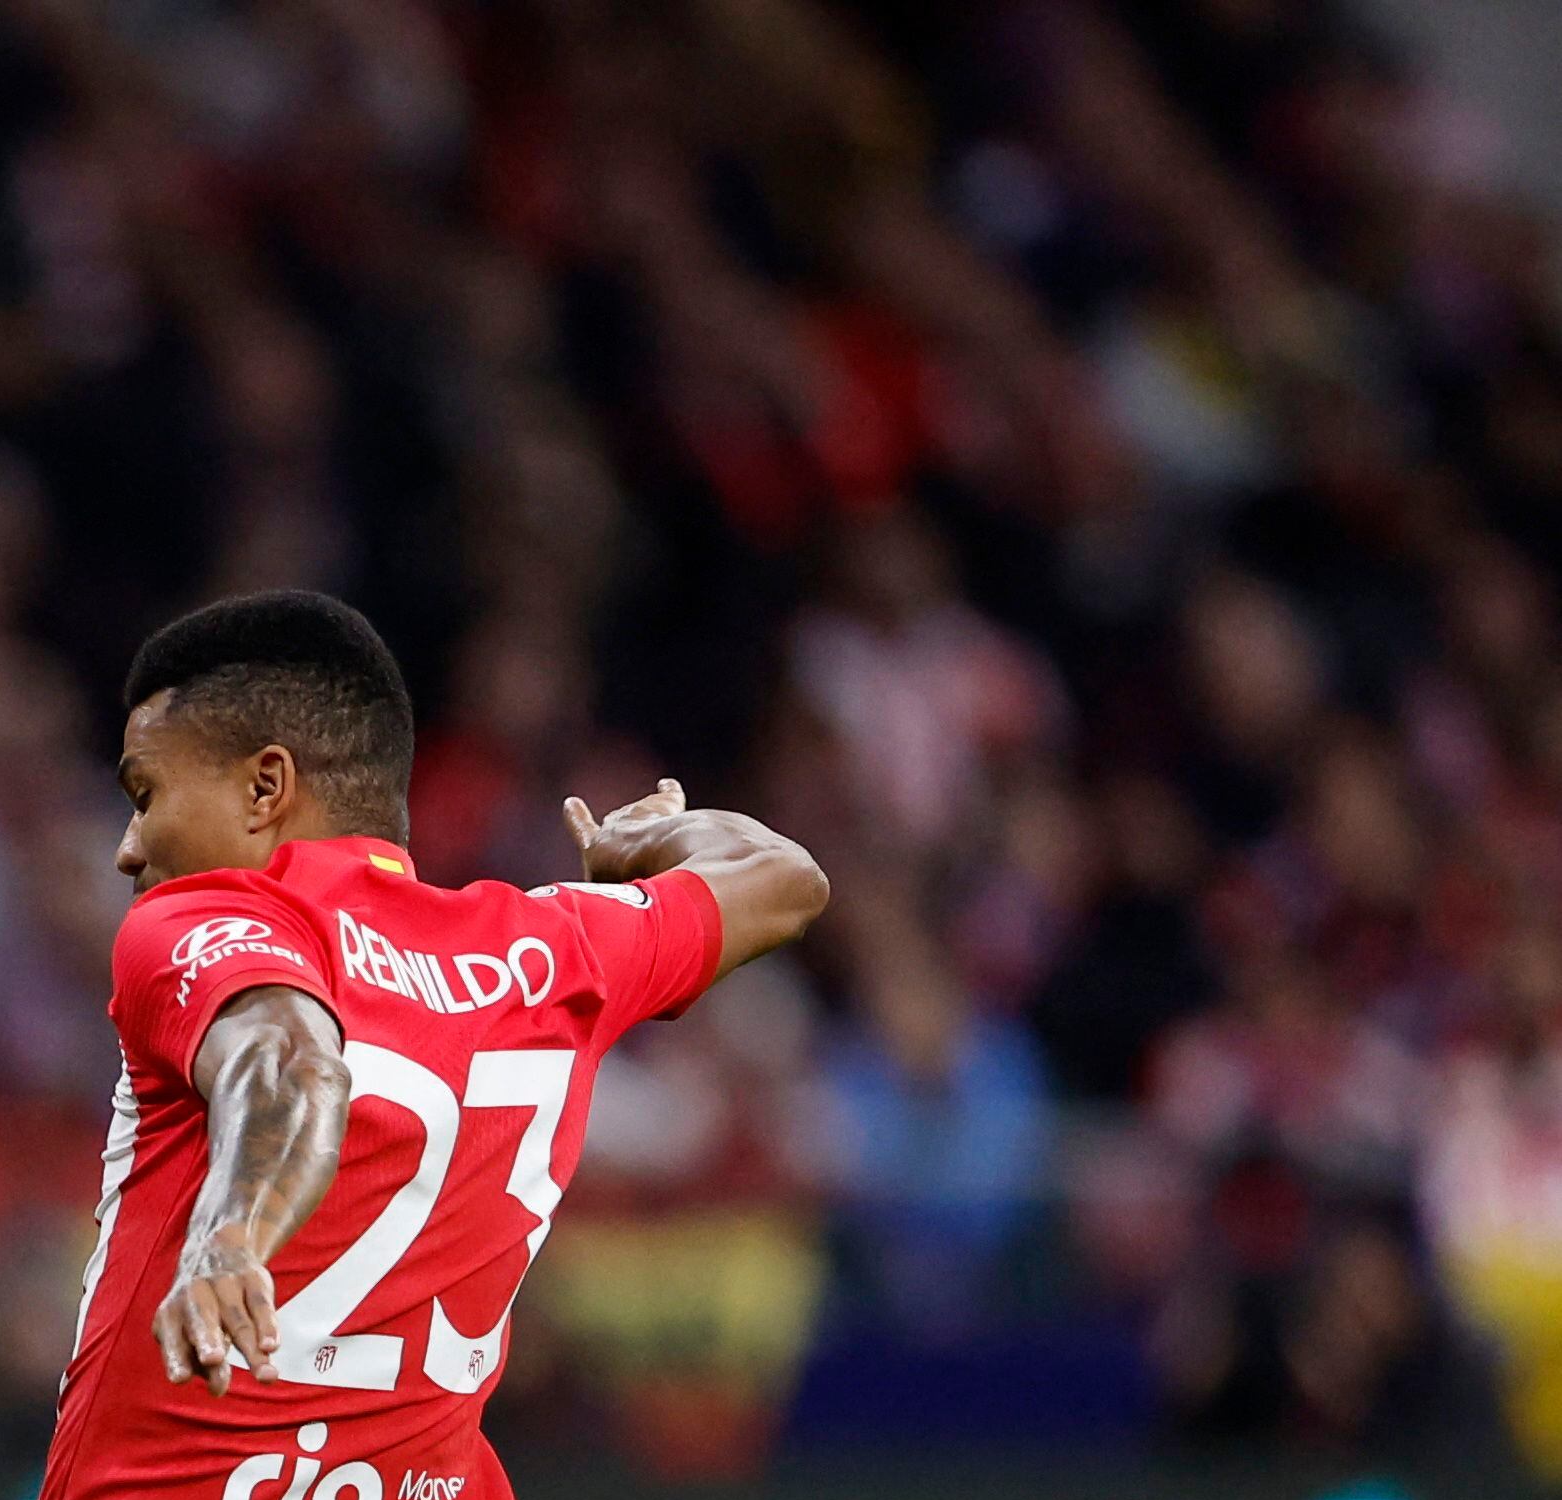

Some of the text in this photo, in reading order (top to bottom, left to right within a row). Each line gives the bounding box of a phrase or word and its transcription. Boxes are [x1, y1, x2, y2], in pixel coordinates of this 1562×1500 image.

[176, 941, 305, 1008] HYUNDAI
[337, 909, 555, 1014] REINILDO
[233, 1040, 577, 1394] 23
